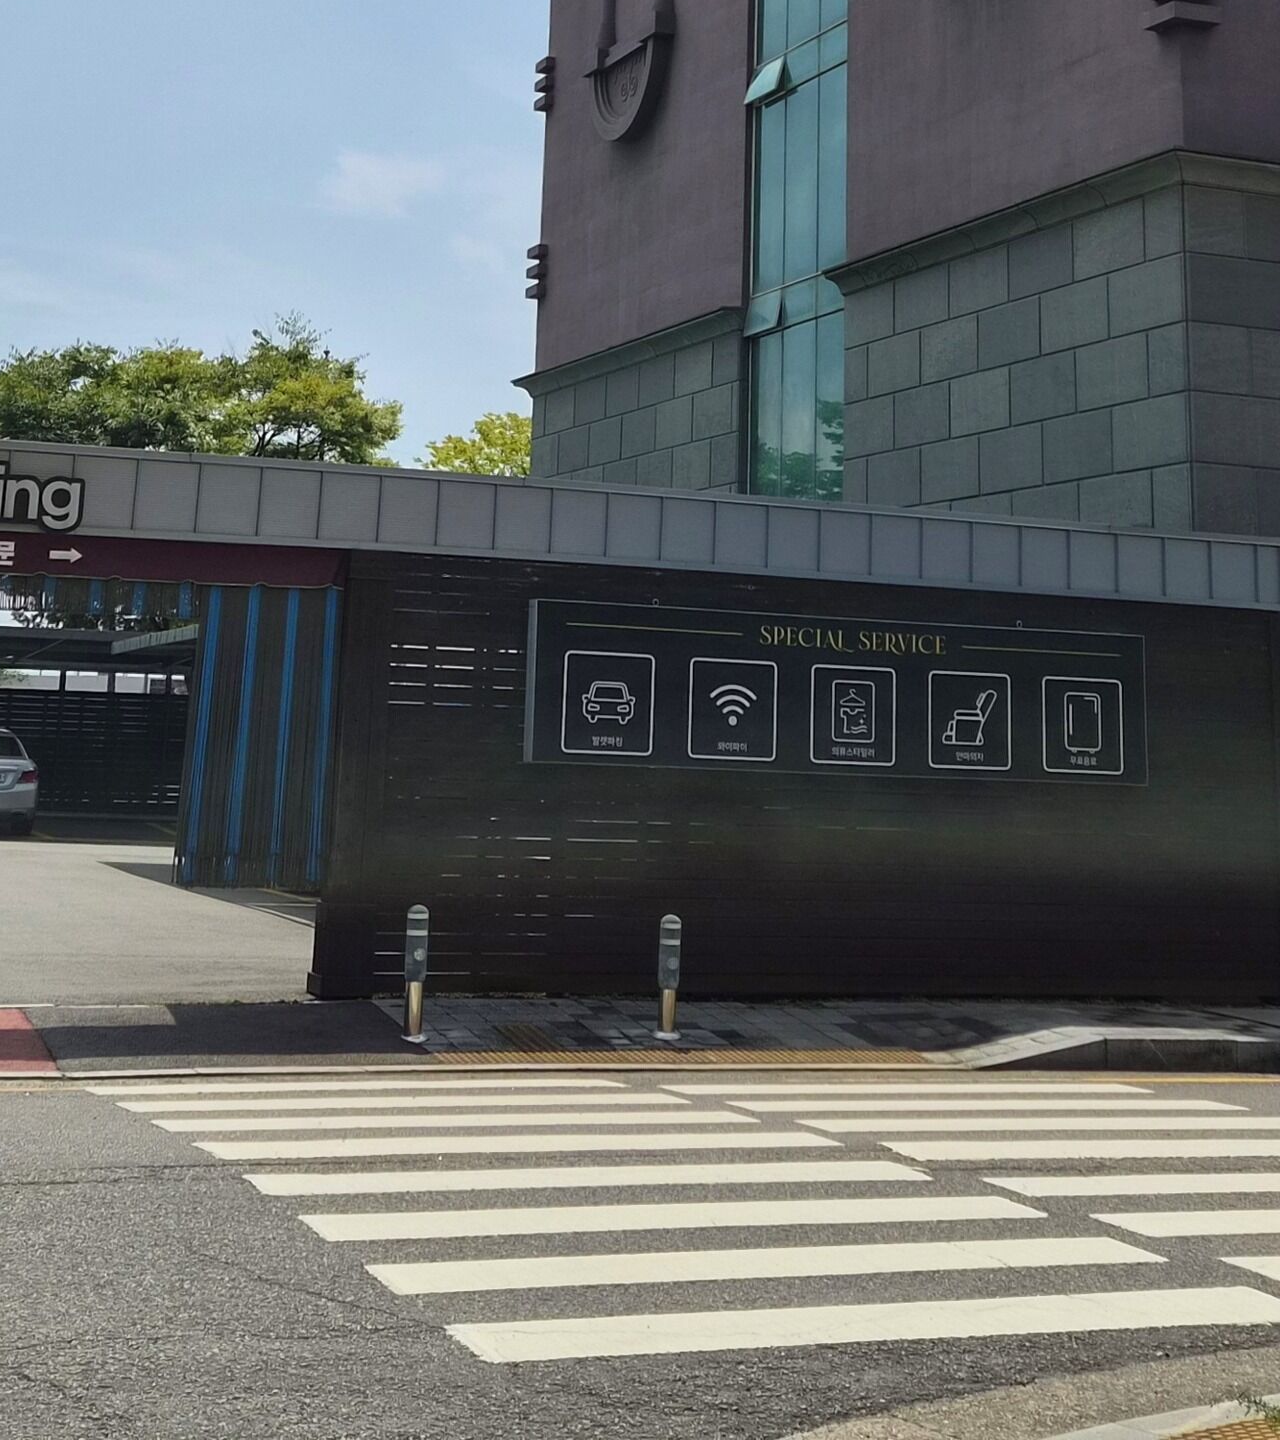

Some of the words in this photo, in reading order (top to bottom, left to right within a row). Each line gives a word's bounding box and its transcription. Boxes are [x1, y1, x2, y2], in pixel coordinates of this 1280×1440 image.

[759, 624, 855, 653] SPECIAL
[858, 631, 947, 656] SERVICE
[717, 741, 748, 752] 와이파이
